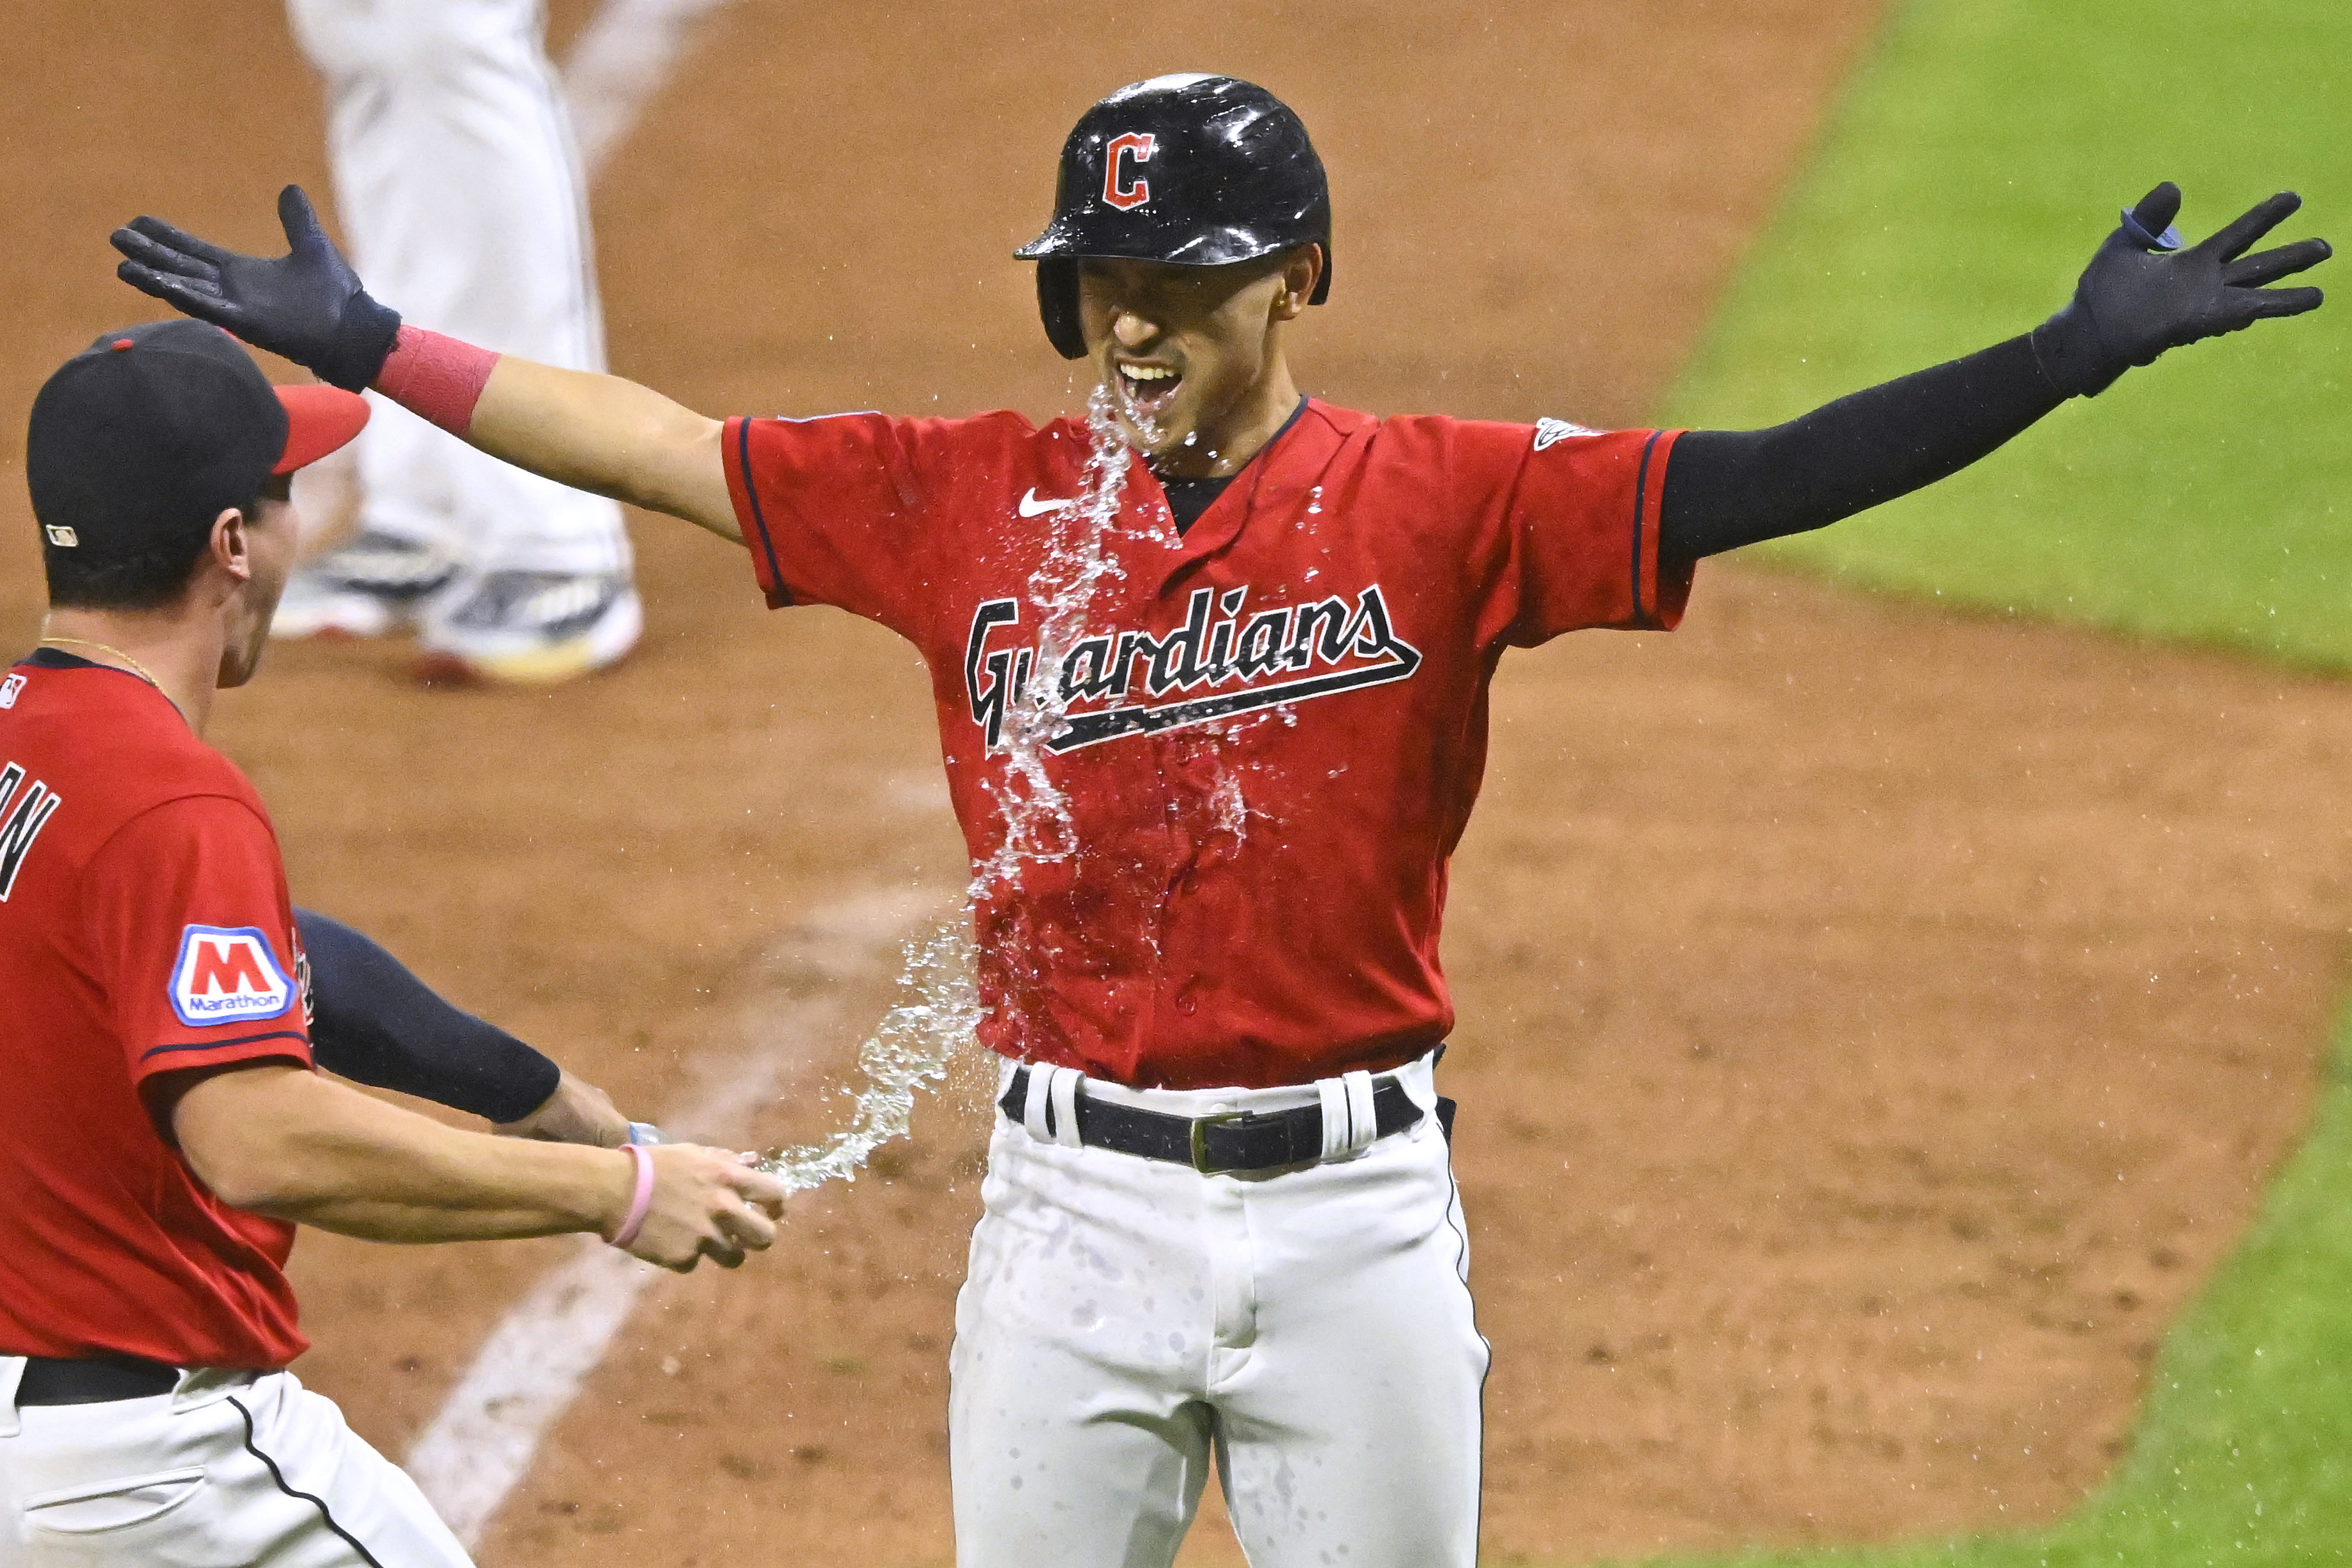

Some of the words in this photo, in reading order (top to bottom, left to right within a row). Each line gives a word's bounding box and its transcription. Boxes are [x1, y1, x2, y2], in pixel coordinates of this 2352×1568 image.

[1102, 132, 1155, 212] C
[965, 583, 1423, 761] Guardians
[190, 940, 273, 995] M
[190, 994, 280, 1012] Marathon
